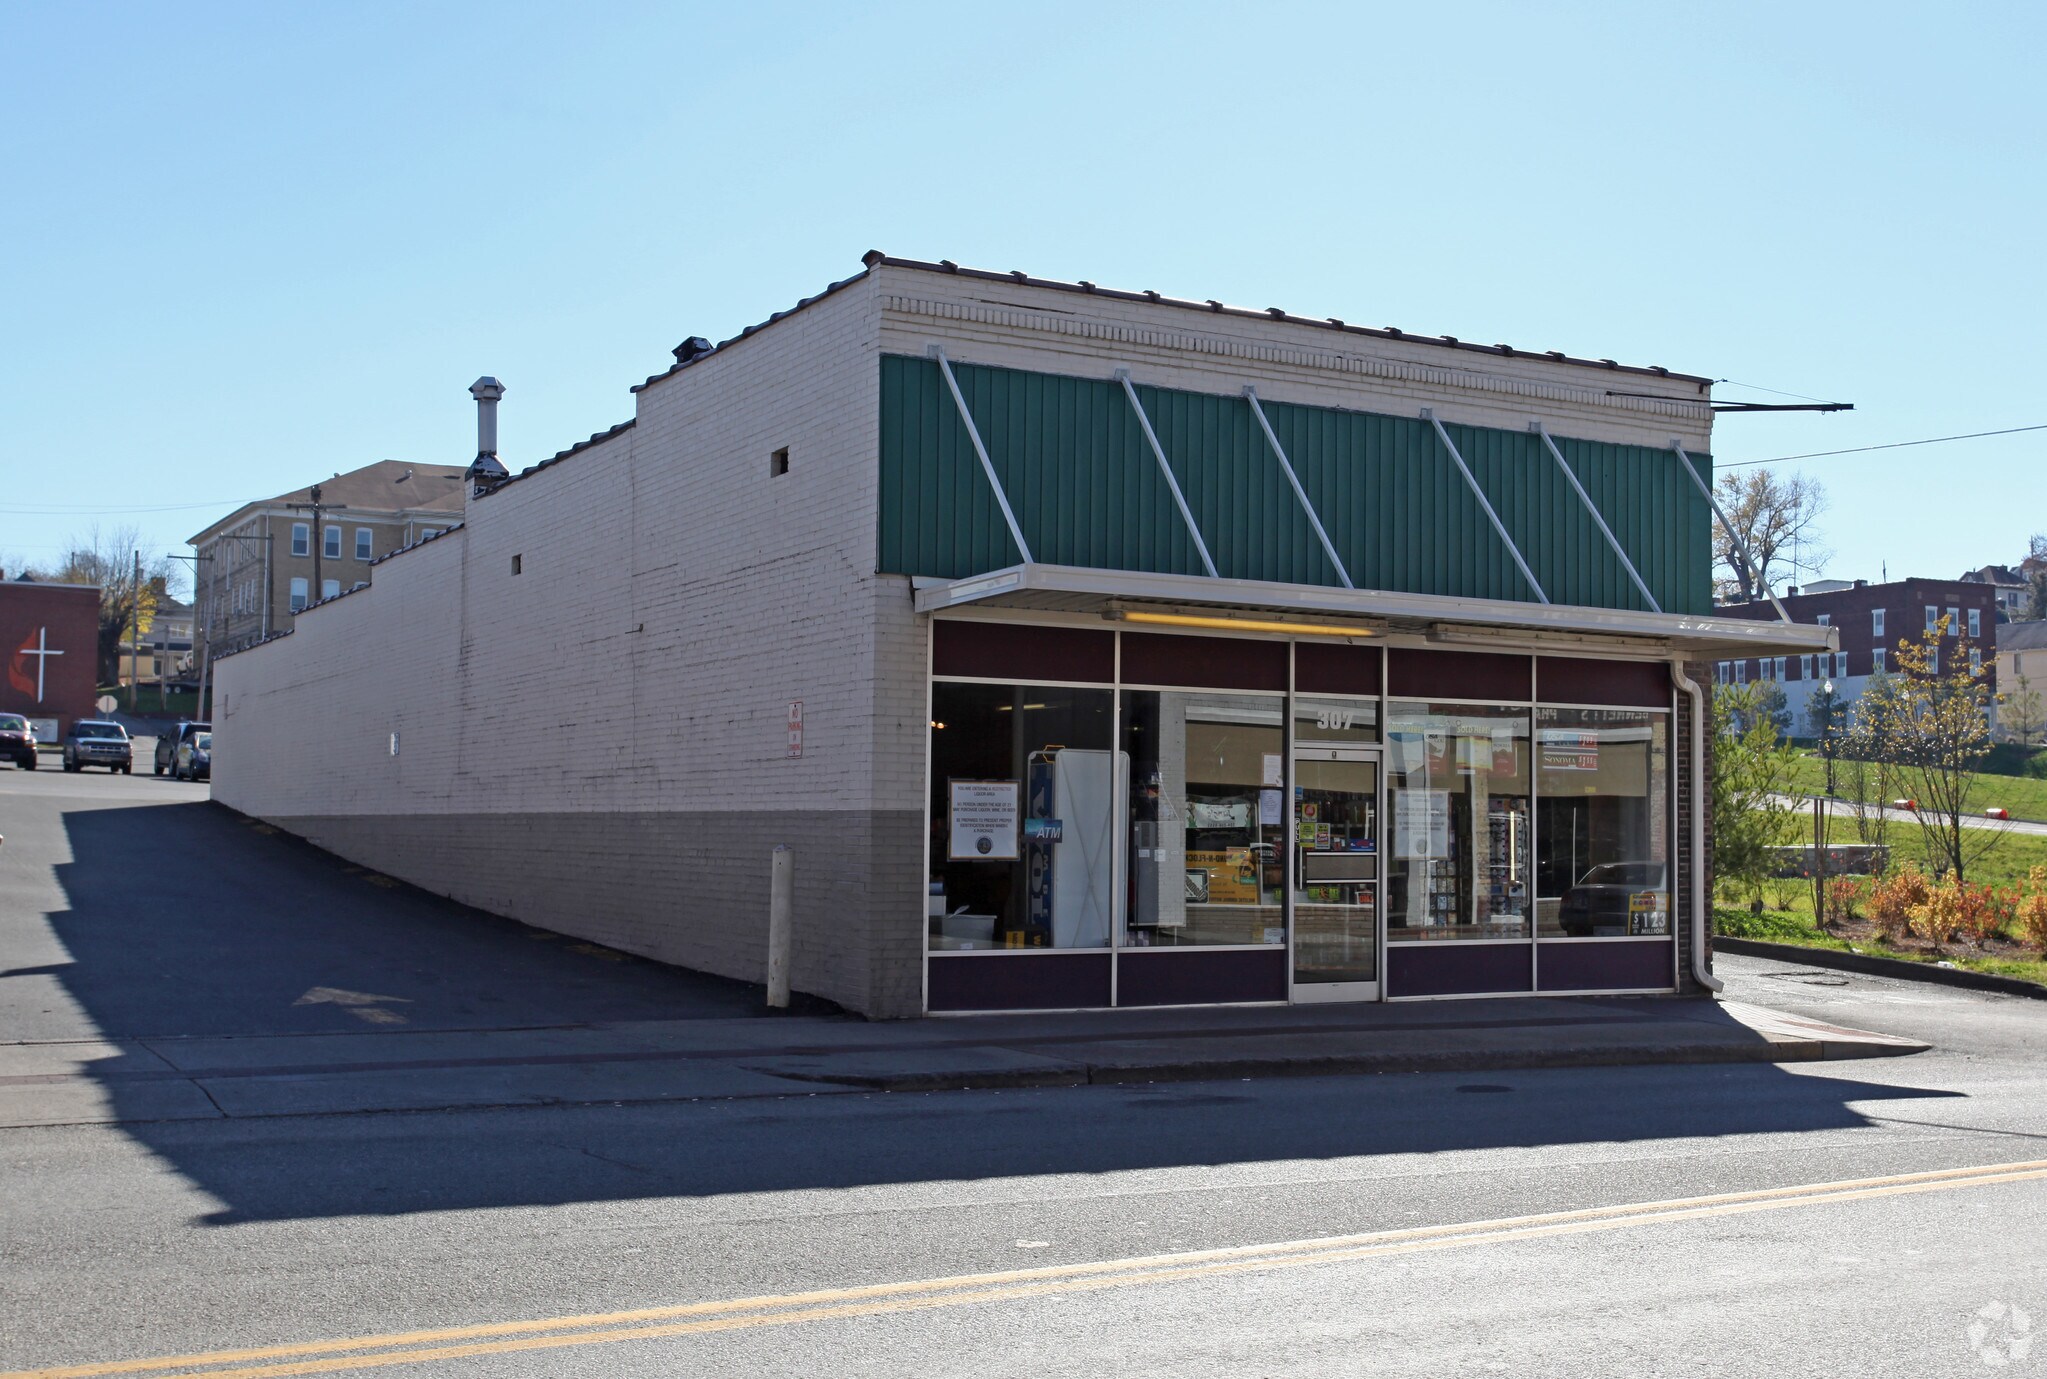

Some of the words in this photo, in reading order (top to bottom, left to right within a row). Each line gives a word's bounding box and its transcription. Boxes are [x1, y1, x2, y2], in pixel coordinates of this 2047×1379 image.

[1317, 710, 1354, 730] 307
[1457, 725, 1474, 733] SOLD
[1544, 755, 1576, 764] SONOMA
[1036, 827, 1061, 839] ATM
[1643, 912, 1666, 927] 123
